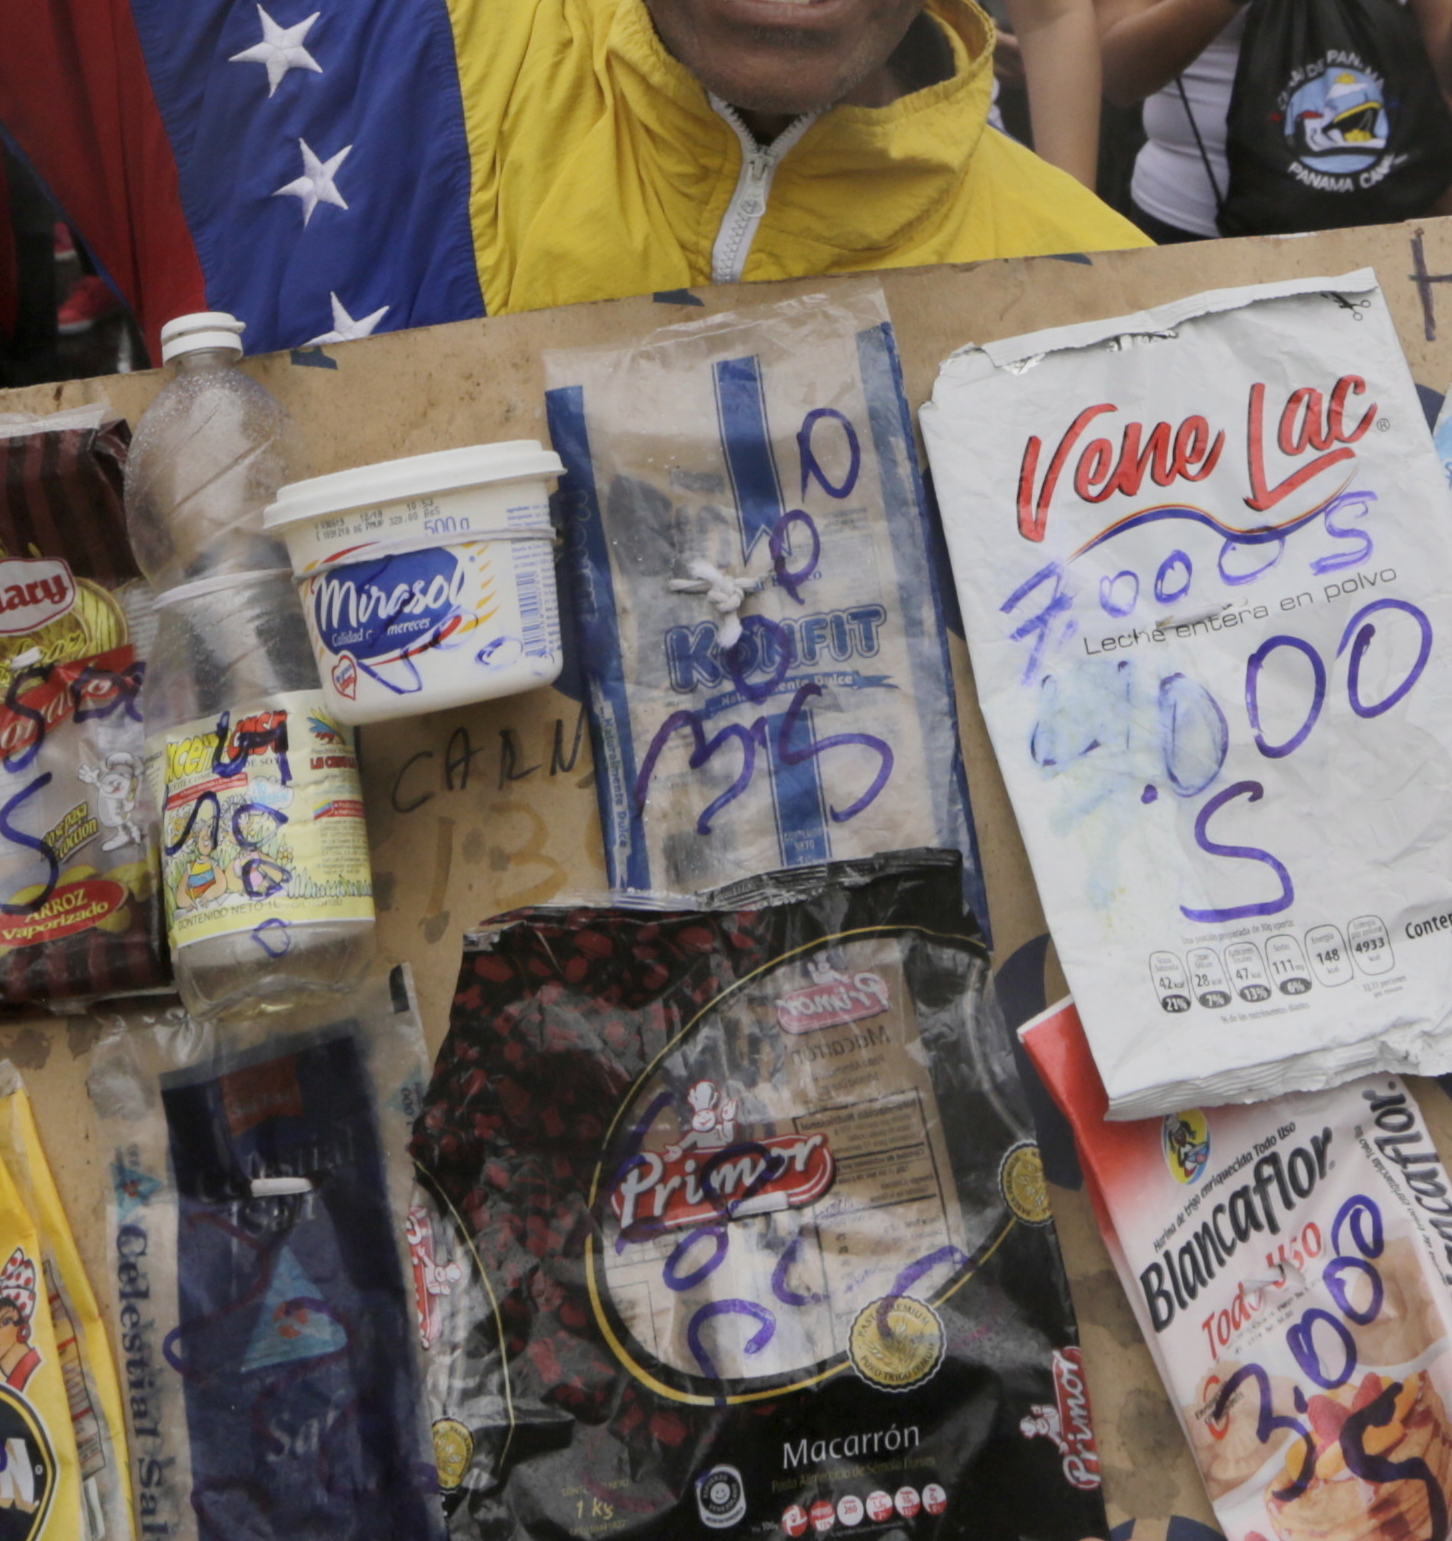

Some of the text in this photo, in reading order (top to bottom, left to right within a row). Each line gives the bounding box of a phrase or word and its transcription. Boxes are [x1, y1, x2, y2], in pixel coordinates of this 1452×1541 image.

[1288, 161, 1354, 192] PANAMA
[1016, 374, 1379, 543] Vene Lac
[315, 567, 465, 631] Mirasol
[1083, 565, 1398, 656] Leche entera en polvo
[387, 617, 431, 637] mereces
[665, 603, 887, 694] KONFIT
[616, 809, 629, 849] Dulce
[1, 901, 109, 940] Vaporizado
[24, 887, 88, 924] ARROZ
[177, 901, 264, 932] CONTENIDO NETO
[1315, 948, 1341, 965] 148
[1354, 937, 1387, 954] 4933
[1158, 975, 1173, 990] 42
[1194, 973, 1210, 988] 28
[1235, 967, 1250, 981] 47
[1272, 959, 1295, 975] 111
[1207, 992, 1226, 1006] 7%
[1242, 986, 1269, 1001] 13%
[1286, 978, 1306, 994] 6%
[1164, 996, 1189, 1011] 21%
[1200, 1150, 1254, 1199] enriquecida
[1253, 1130, 1277, 1159] Todo
[1140, 1127, 1334, 1333] Blancaflor
[1052, 1348, 1102, 1490] Primor
[781, 1423, 922, 1470] Macarrón
